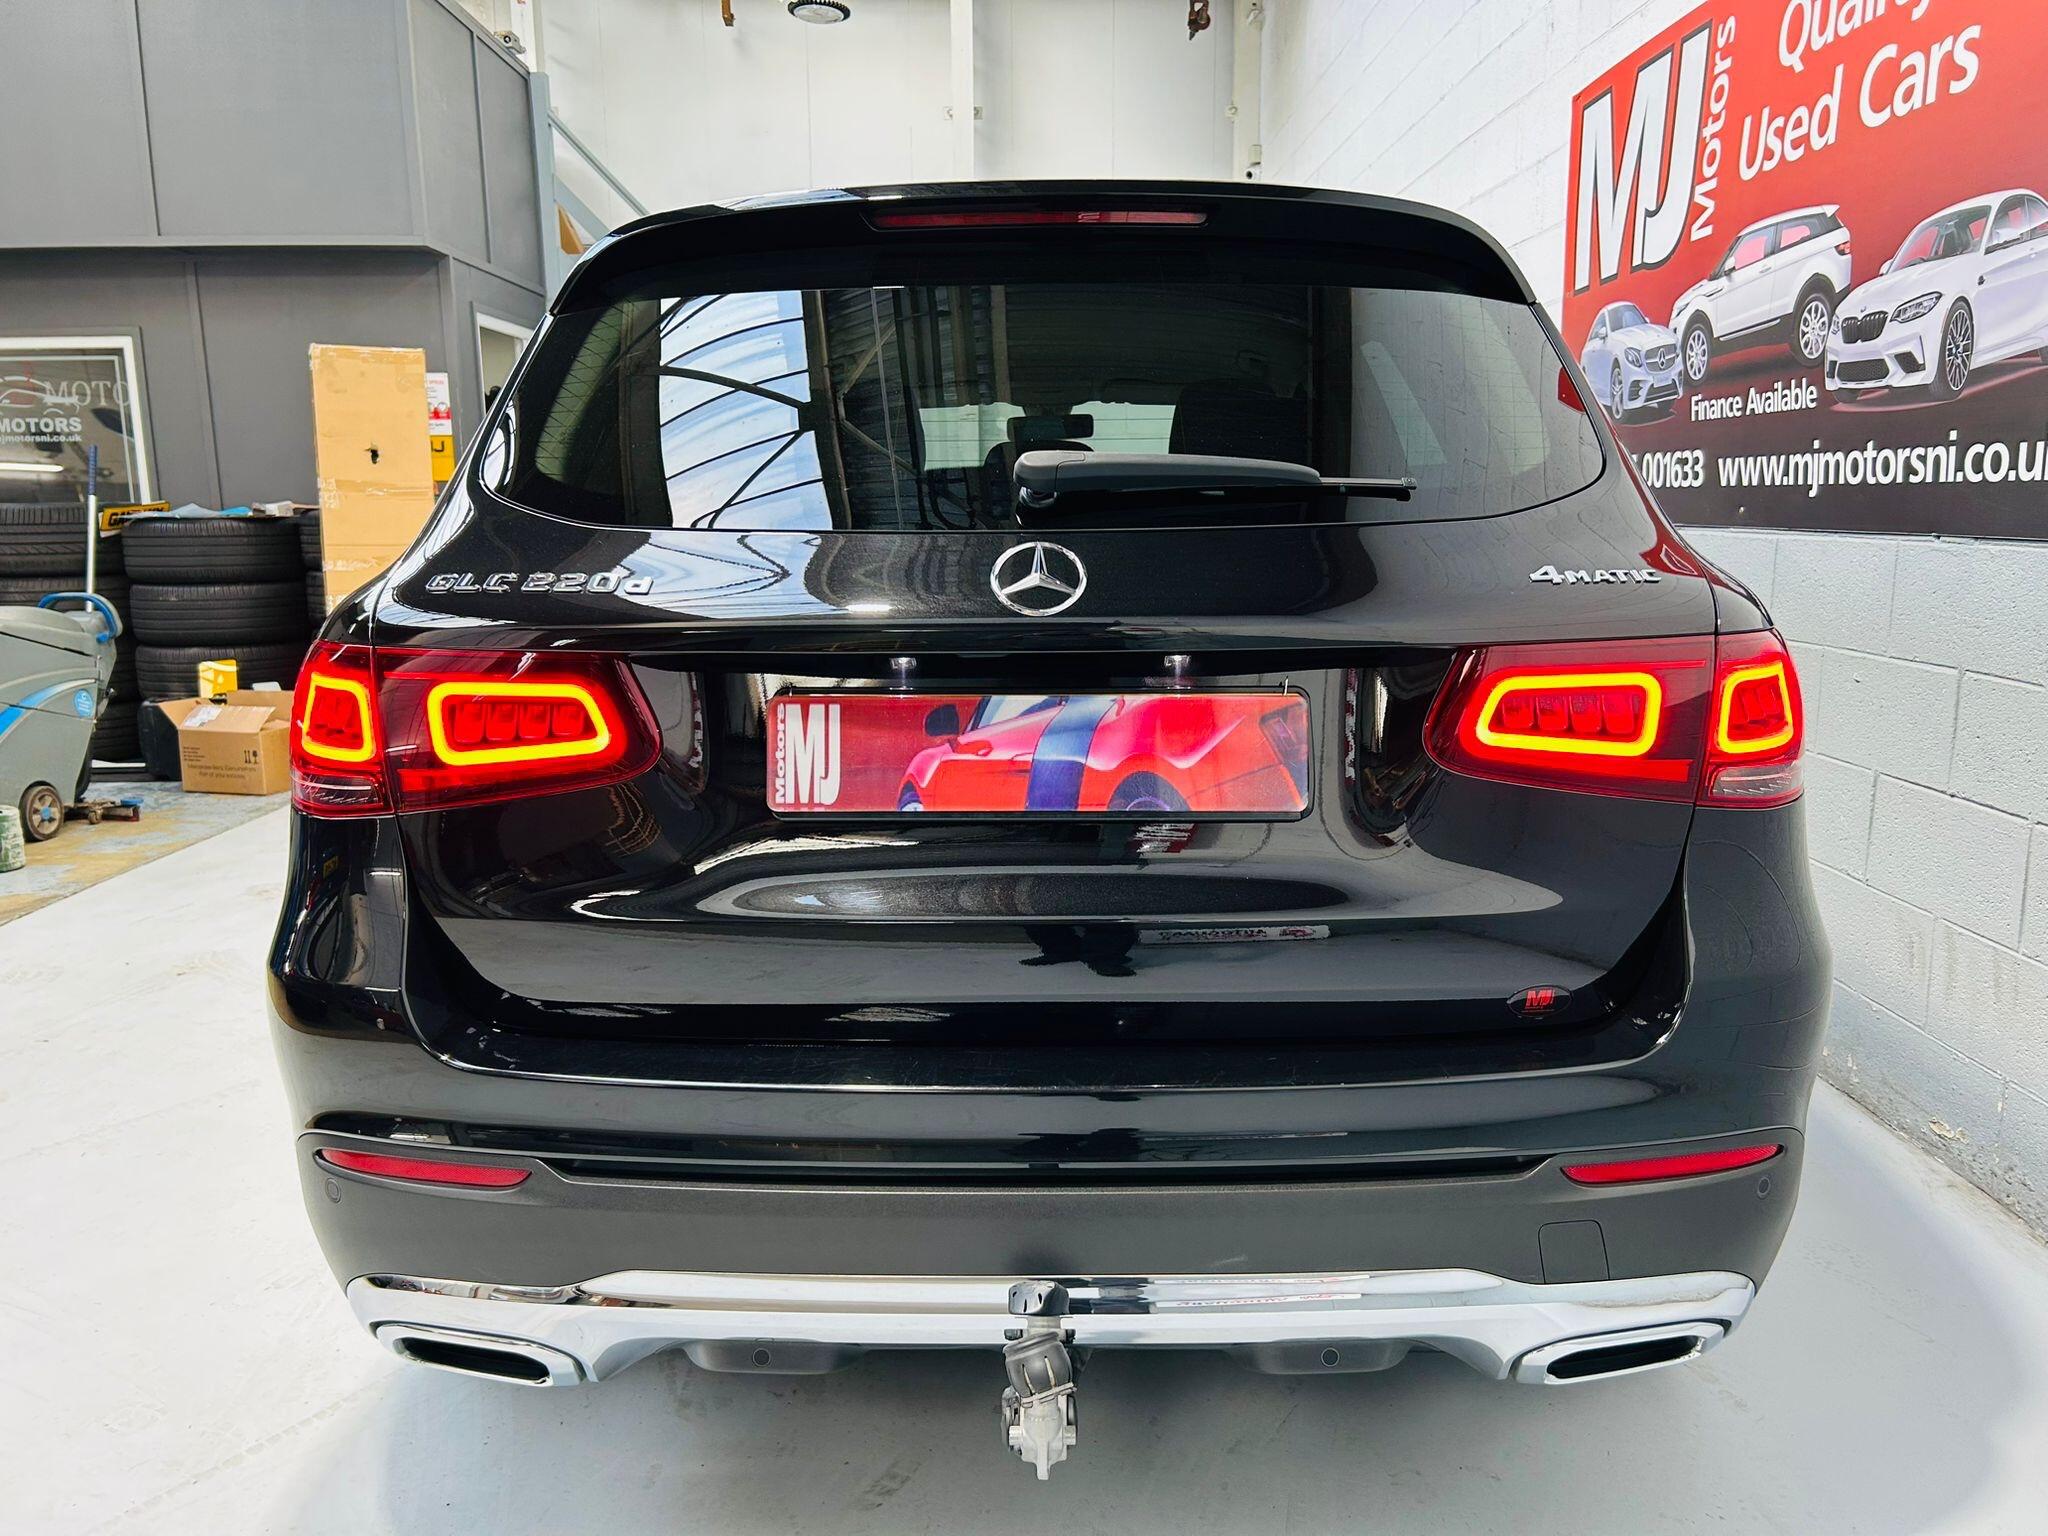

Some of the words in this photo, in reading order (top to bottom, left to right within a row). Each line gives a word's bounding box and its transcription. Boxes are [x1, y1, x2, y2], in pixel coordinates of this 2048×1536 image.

[1691, 15, 1735, 242] Motors
[1738, 63, 1843, 181] Used
[1859, 24, 1981, 128] Cars
[1573, 26, 1710, 293] MJ
[0, 433, 82, 445] jmotorsni.co.uk
[1690, 393, 1743, 422] Finance
[1746, 377, 1818, 416] Available
[1717, 430, 2048, 497] www.mjmotorsni.co.u
[426, 571, 519, 594] GLC
[1529, 565, 1662, 585] 4MATIC
[775, 702, 785, 804] Motors
[785, 703, 841, 806] MJ
